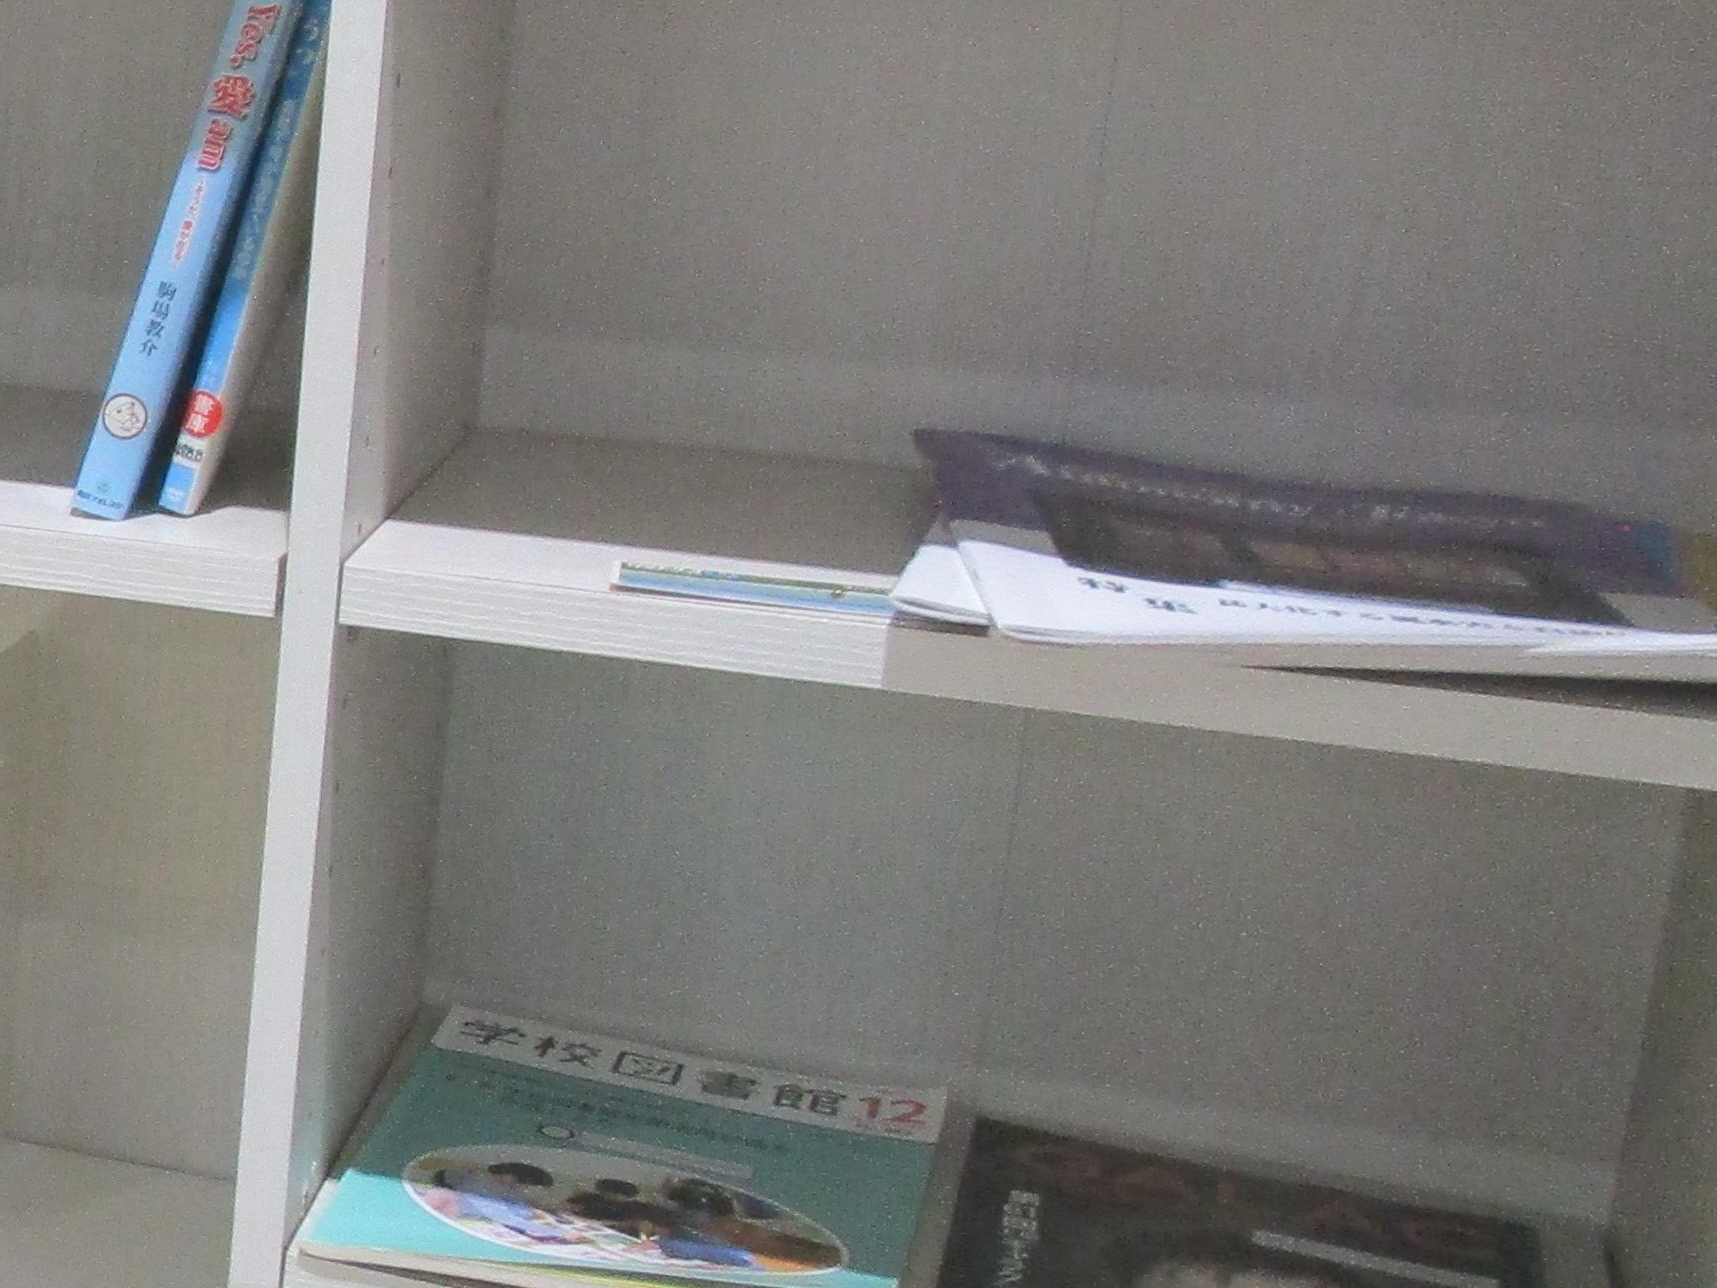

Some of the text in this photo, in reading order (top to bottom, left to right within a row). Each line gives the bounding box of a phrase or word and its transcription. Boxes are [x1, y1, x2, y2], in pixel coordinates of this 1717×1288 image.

[460, 1018, 846, 1118] 学校図書館
